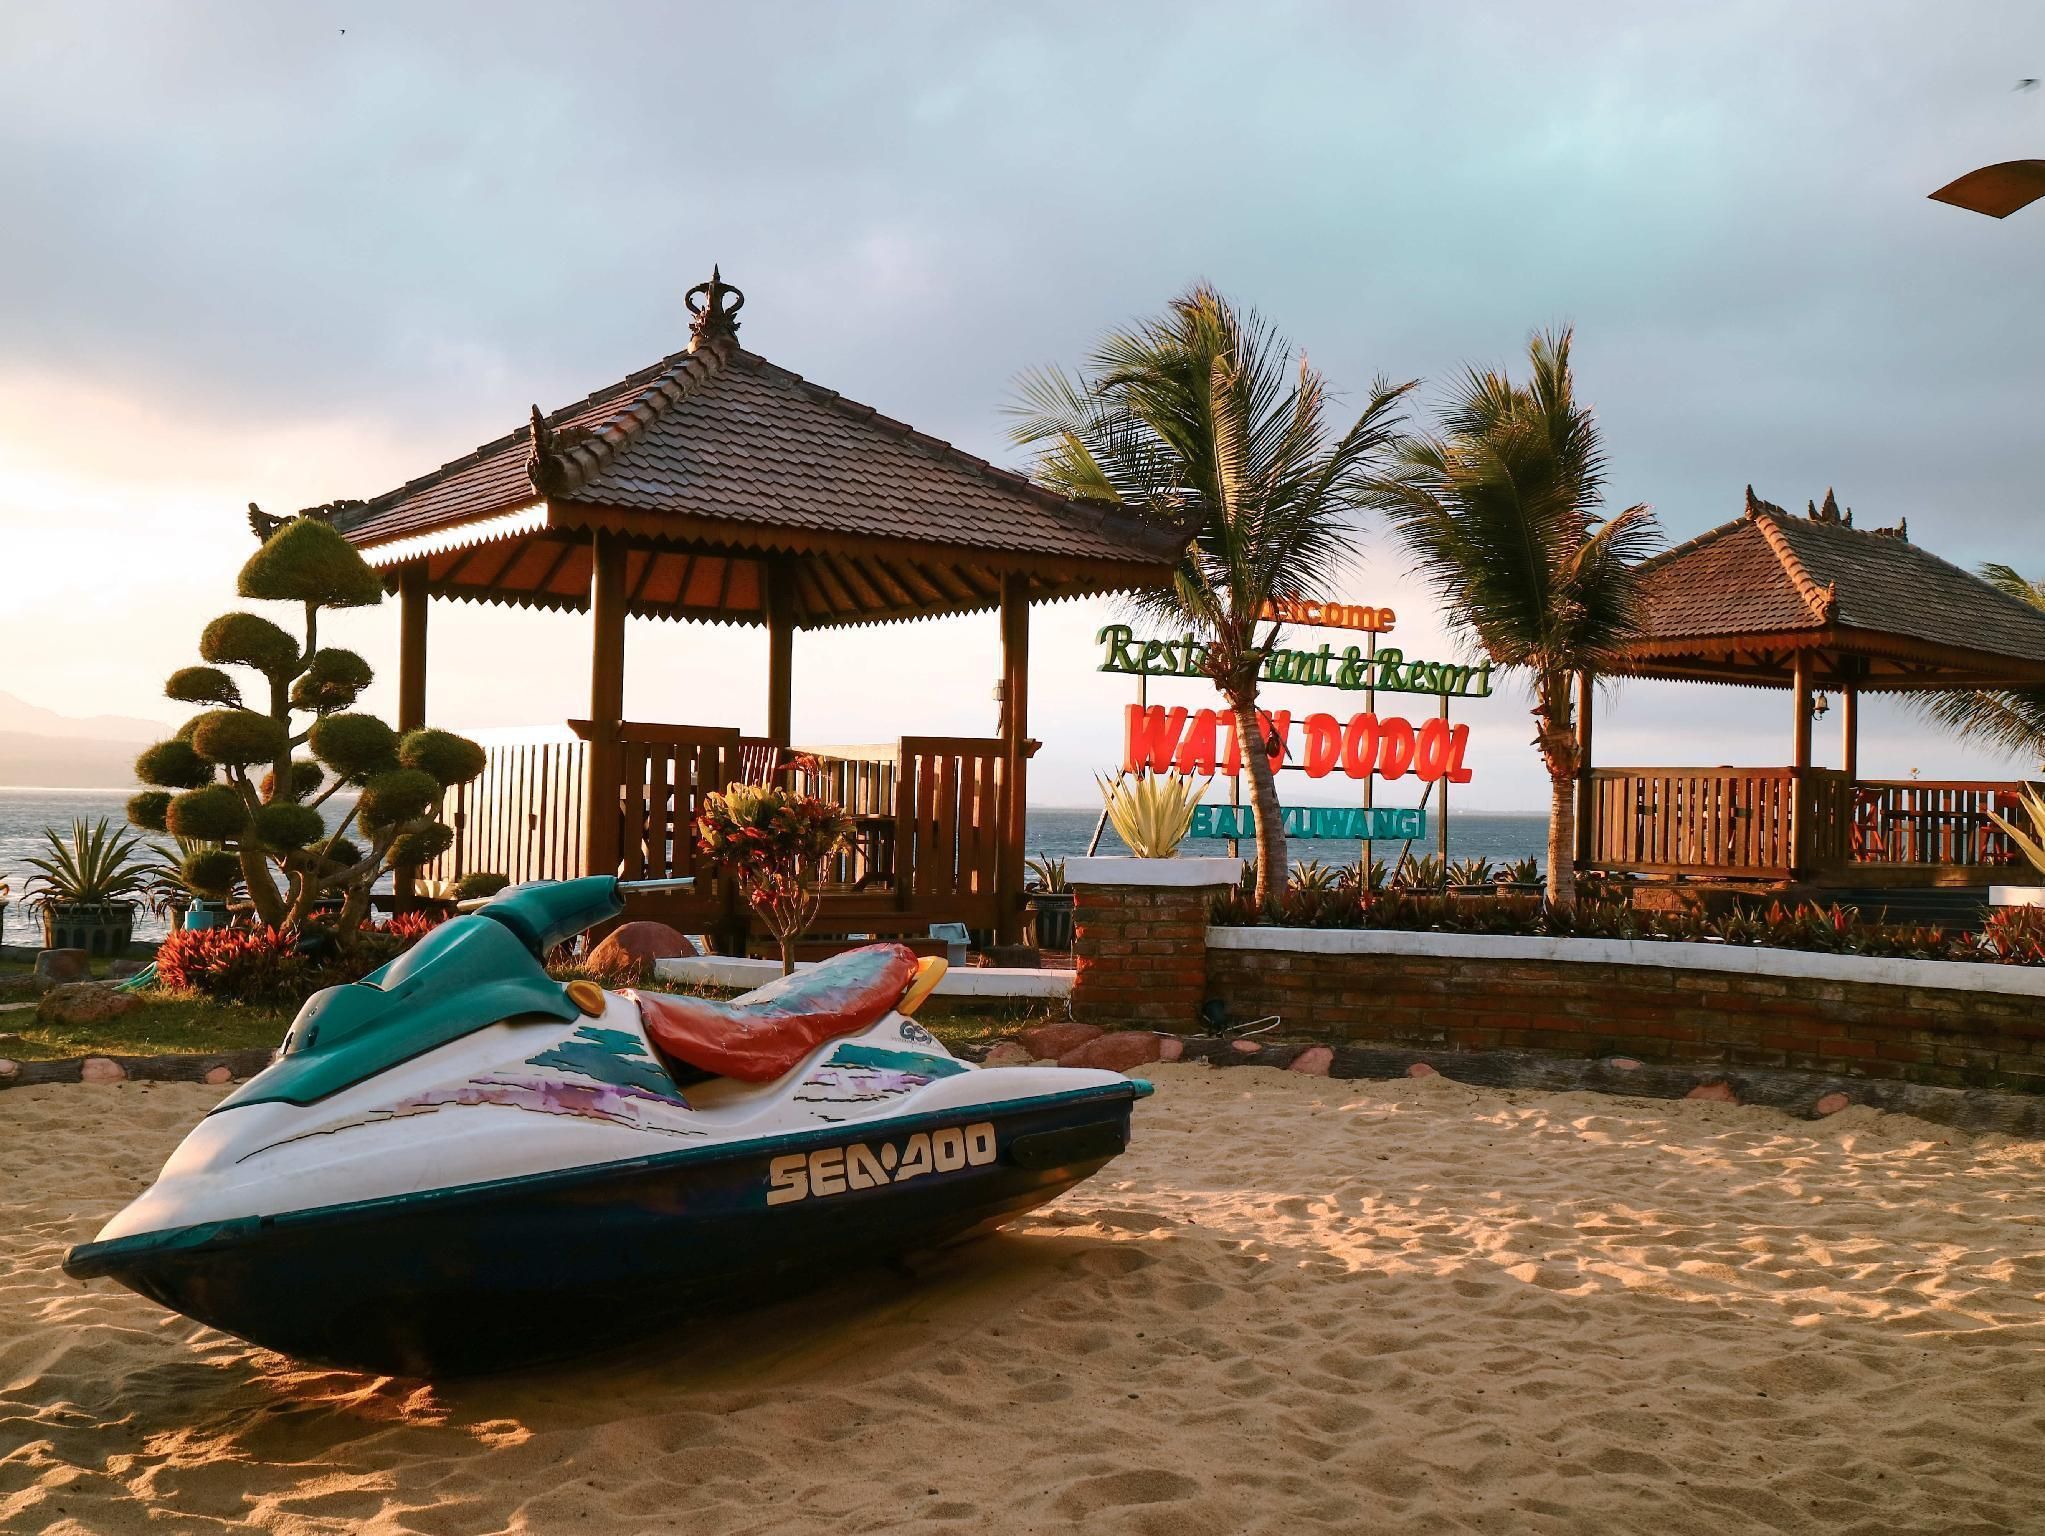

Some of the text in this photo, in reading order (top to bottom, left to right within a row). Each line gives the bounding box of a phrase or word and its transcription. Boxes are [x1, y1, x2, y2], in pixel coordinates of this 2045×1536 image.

[1230, 587, 1396, 633] elcome
[1096, 624, 1496, 697] Restant & Resort
[1303, 712, 1473, 784] DODOL
